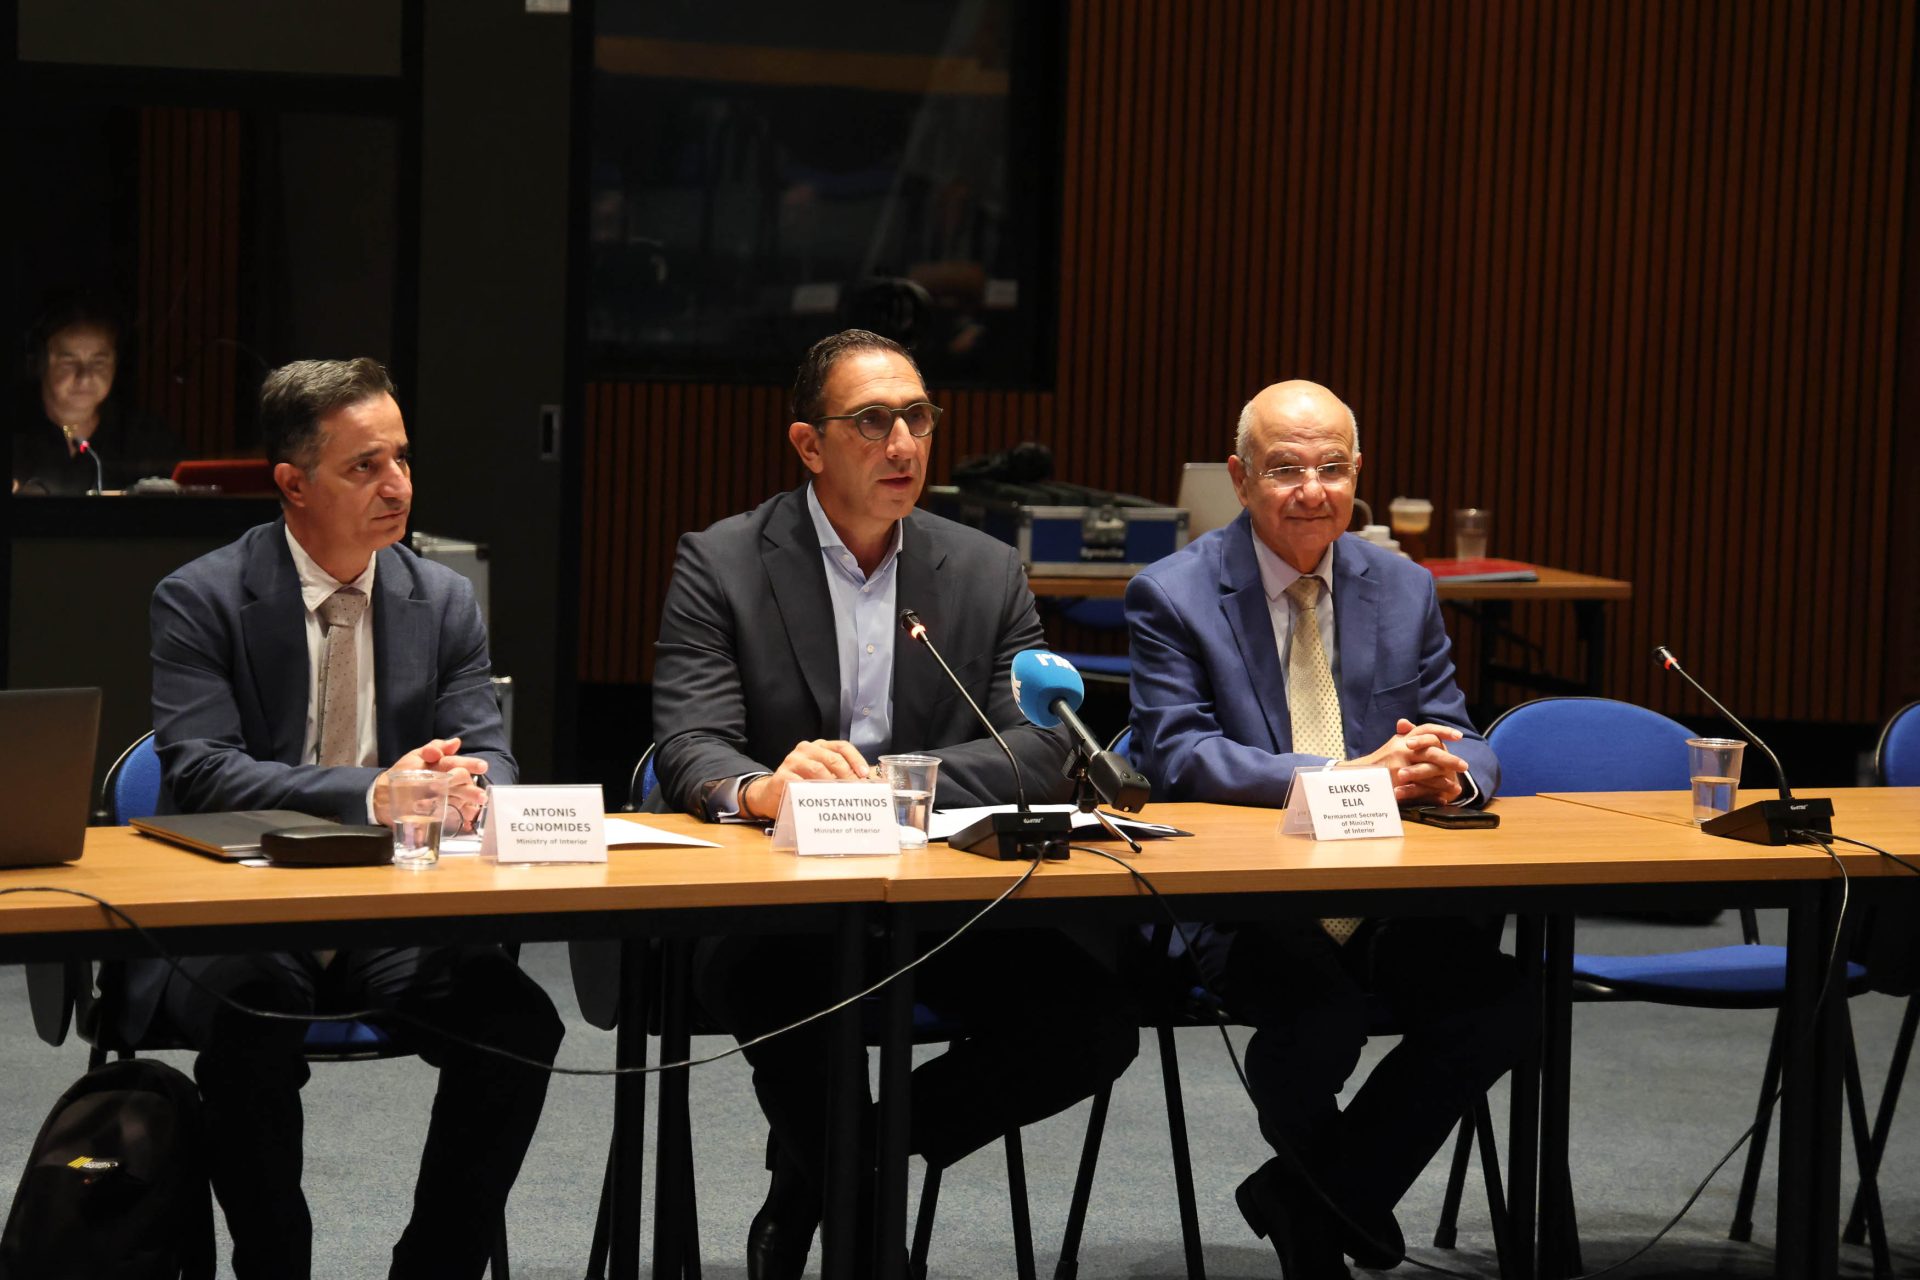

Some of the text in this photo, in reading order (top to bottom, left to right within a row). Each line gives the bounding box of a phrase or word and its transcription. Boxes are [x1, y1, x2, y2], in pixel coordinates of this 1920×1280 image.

[1328, 784, 1371, 794] ELIKKOS
[798, 798, 888, 808] KONSTANTINOS
[1341, 798, 1364, 807] ELIA
[522, 808, 577, 817] ANTONIS
[818, 812, 872, 822] IOANNOU
[510, 823, 591, 832] ECONOMIDES
[516, 838, 548, 846] Ministry
